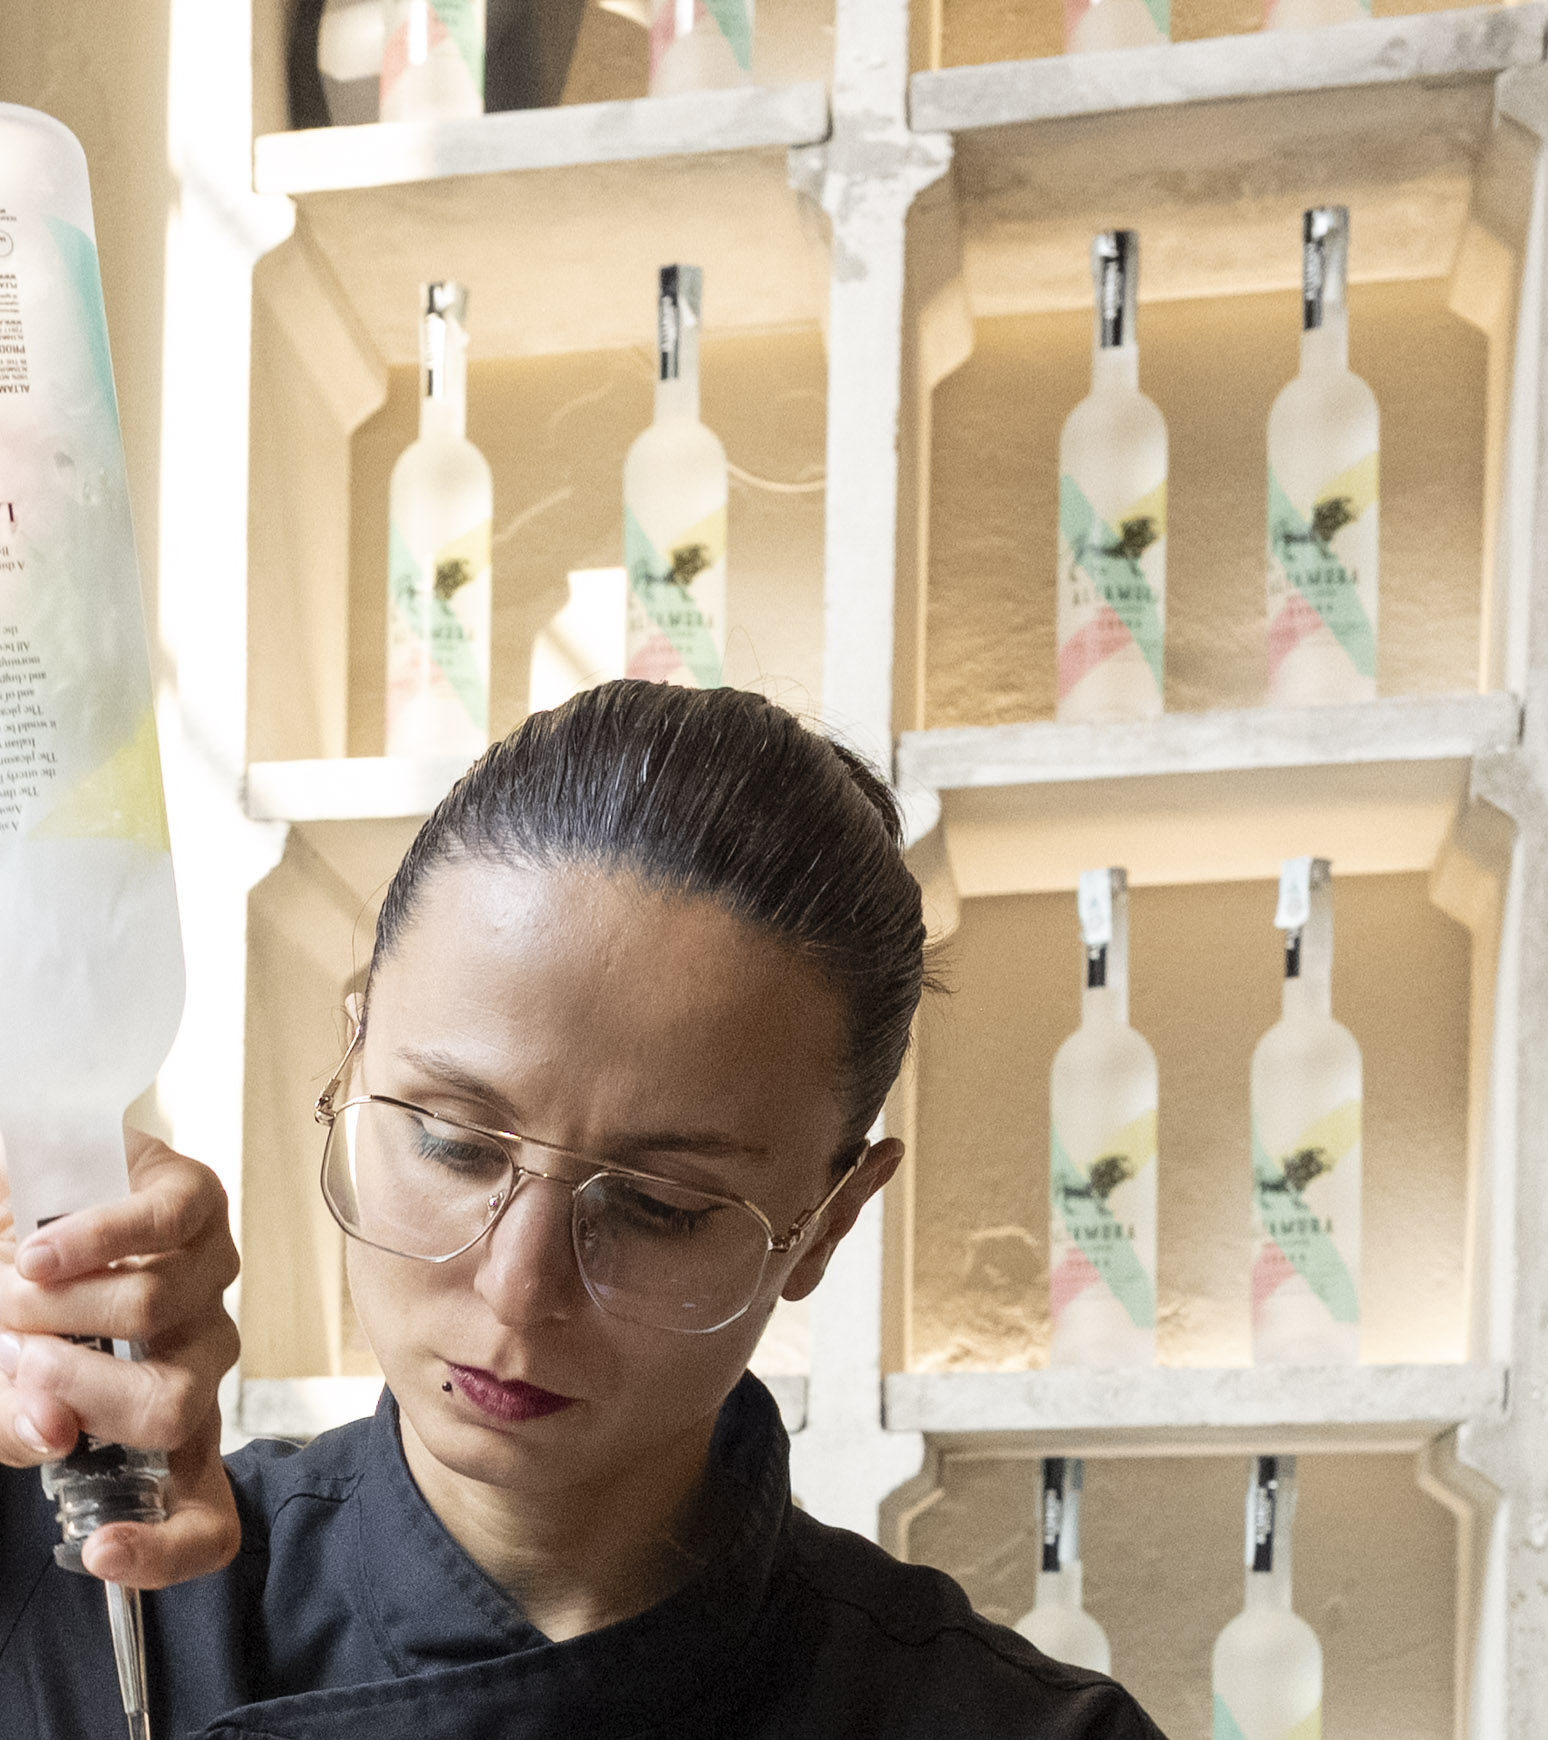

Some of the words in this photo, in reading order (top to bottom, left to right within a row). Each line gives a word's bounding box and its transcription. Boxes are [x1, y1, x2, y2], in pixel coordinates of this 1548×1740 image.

[3, 625, 17, 636] the
[16, 639, 30, 651] All
[29, 672, 45, 682] and
[17, 688, 33, 699] and
[24, 703, 42, 715] The
[3, 723, 14, 734] be
[17, 720, 46, 732] would
[5, 737, 34, 750] Italian
[38, 751, 55, 762] The
[7, 767, 36, 783] utterly
[41, 767, 55, 778] the
[19, 786, 37, 798] The
